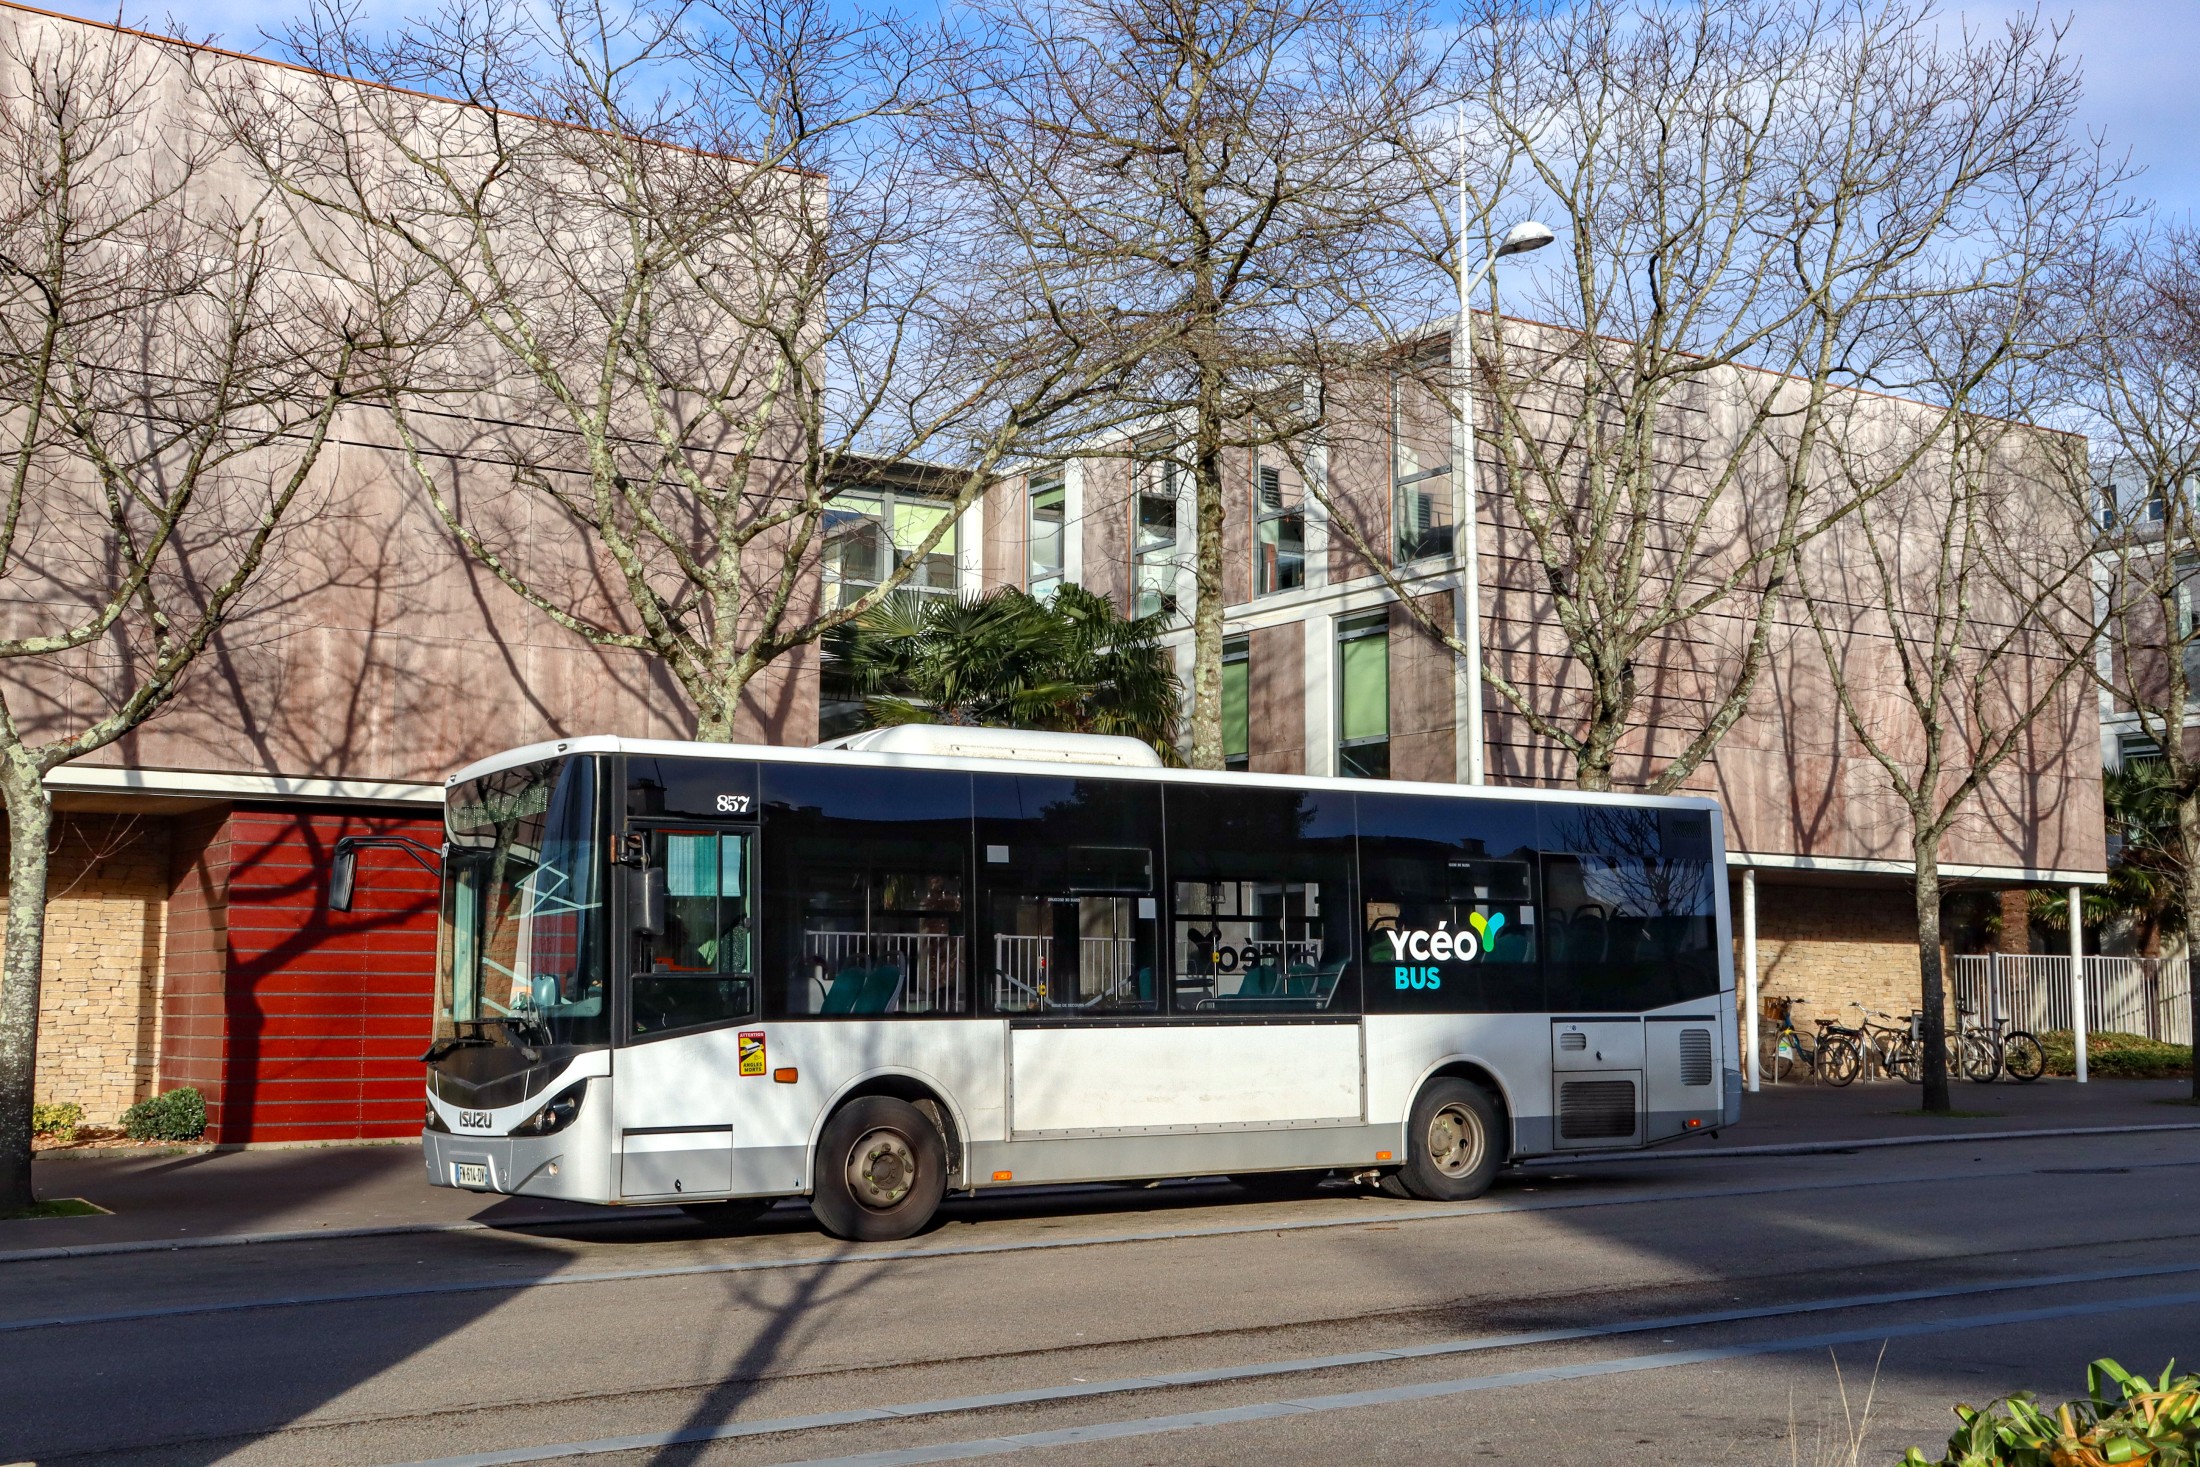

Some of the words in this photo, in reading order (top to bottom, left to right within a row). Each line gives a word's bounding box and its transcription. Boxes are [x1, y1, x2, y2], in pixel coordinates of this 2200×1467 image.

[716, 794, 750, 813] 857
[1386, 920, 1478, 962] Ycéo
[1394, 967, 1441, 990] BUS
[460, 1110, 492, 1128] ISUZU
